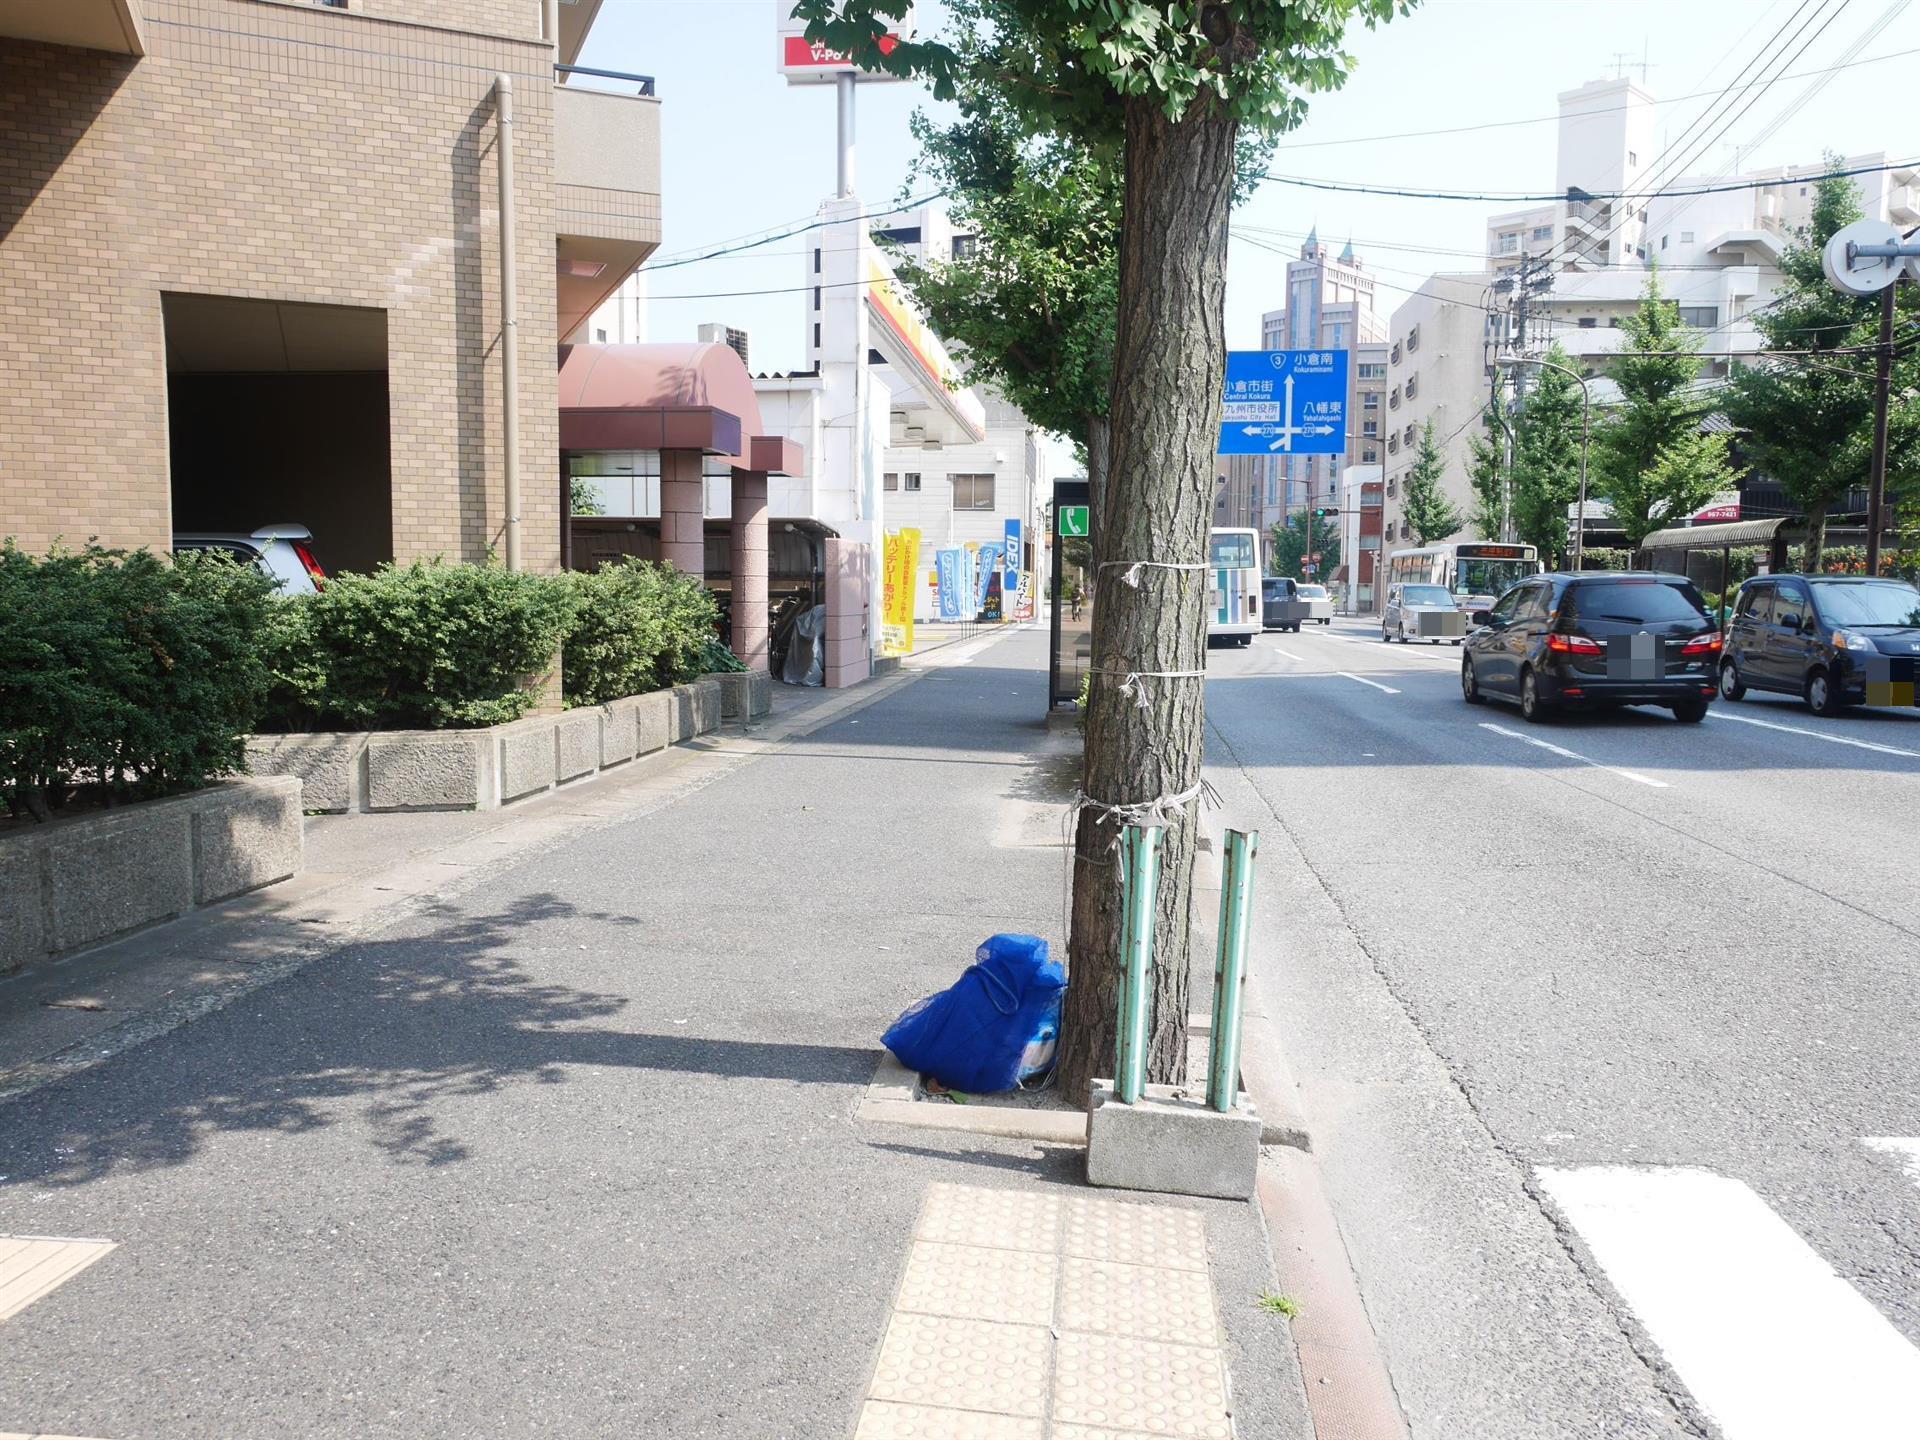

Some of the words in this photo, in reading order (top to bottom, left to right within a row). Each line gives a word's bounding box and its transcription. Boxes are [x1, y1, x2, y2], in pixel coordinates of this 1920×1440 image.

[1275, 356, 1281, 365] 3
[1294, 353, 1333, 365] 小倉南
[1225, 380, 1273, 392] 小倉市街
[1225, 404, 1279, 414] 九州市役所
[1303, 402, 1342, 414] 八幡東
[1303, 415, 1342, 423] Yahatahigashi
[1006, 534, 1019, 575] IDEX
